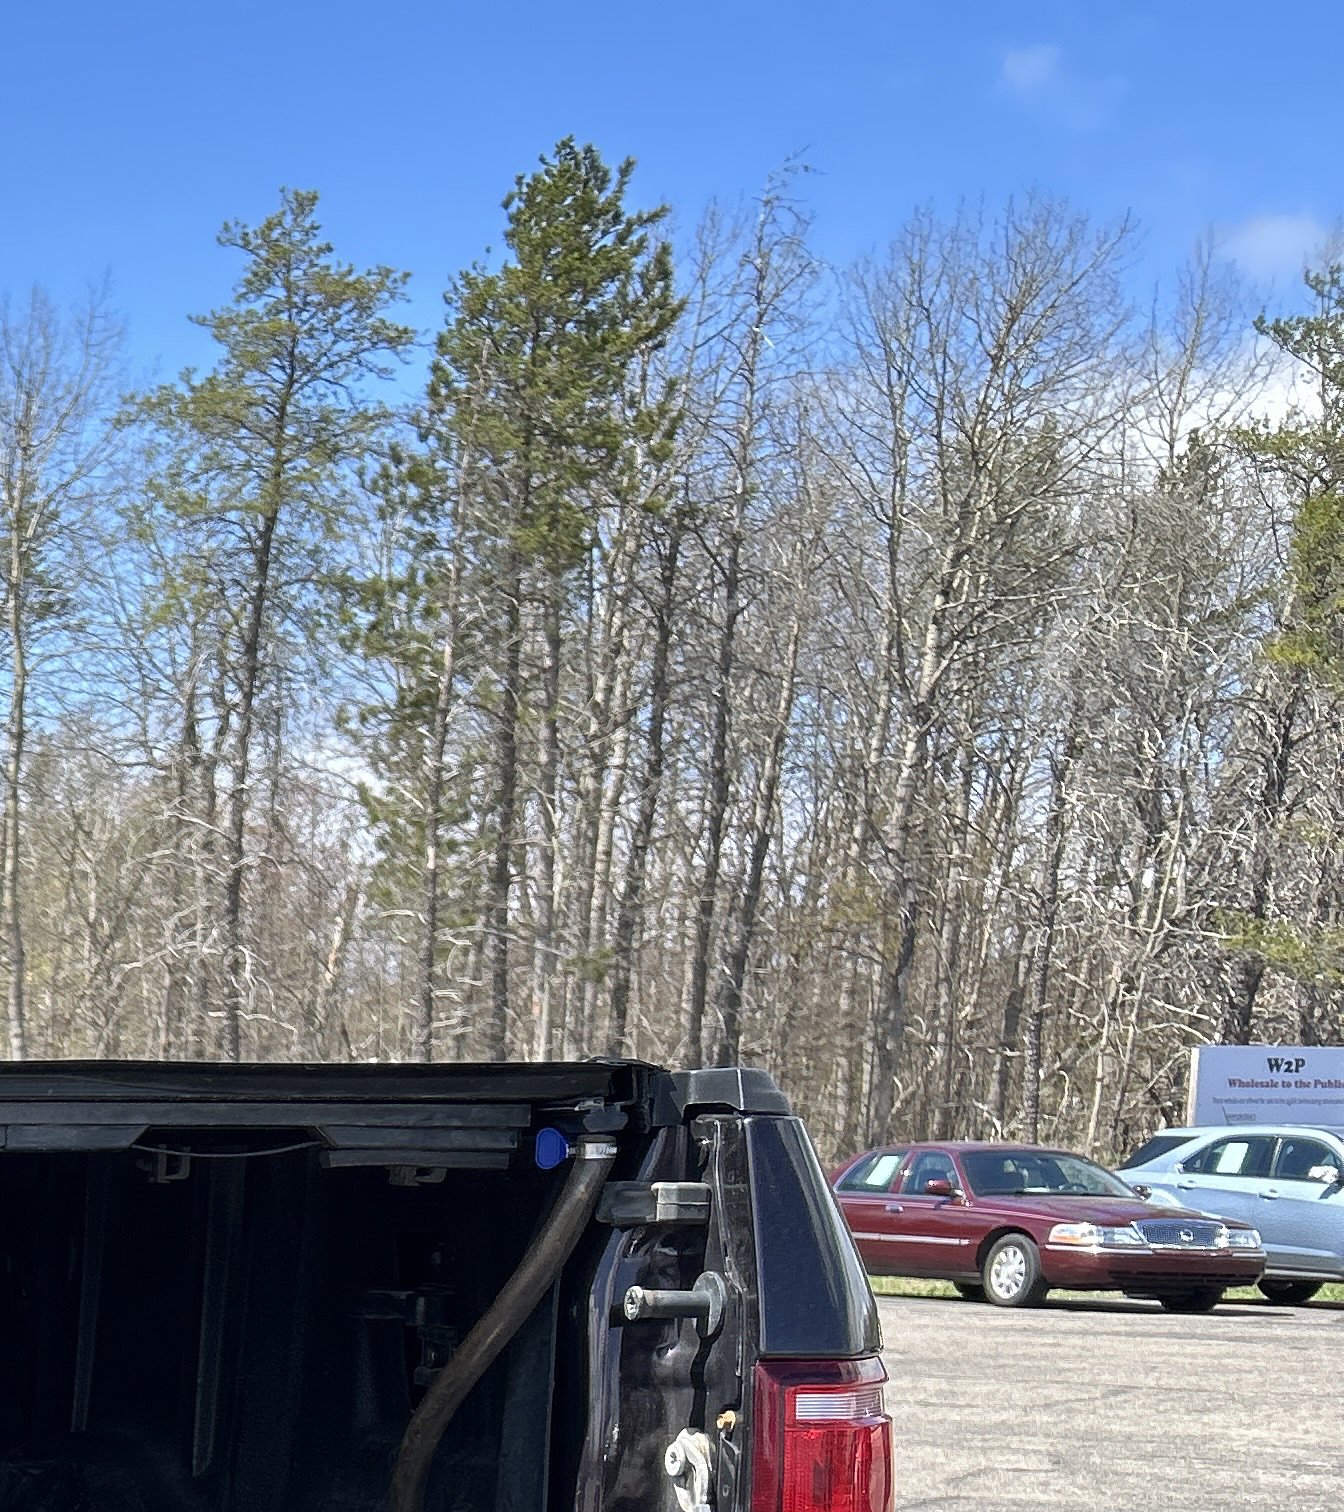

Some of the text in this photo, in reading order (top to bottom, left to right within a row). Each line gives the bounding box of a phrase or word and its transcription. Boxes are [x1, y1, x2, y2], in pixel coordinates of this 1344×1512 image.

[1267, 1057, 1306, 1074] W2P
[1228, 1078, 1279, 1089] Wholesale
[1282, 1079, 1292, 1089] to
[1295, 1078, 1311, 1089] the
